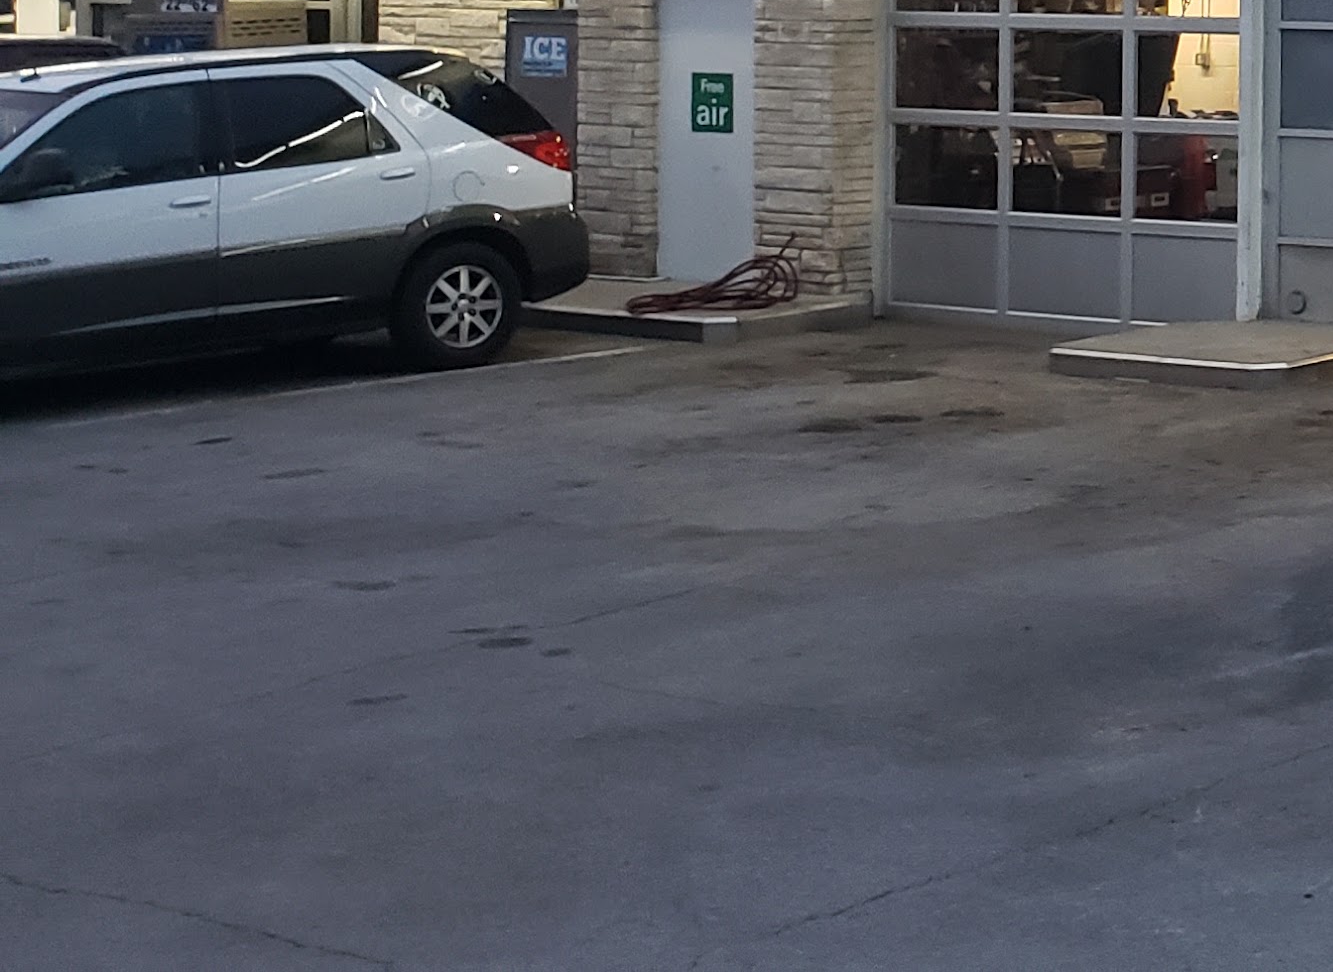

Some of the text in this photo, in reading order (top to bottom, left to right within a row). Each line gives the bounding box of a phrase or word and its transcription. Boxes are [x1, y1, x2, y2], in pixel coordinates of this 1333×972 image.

[524, 36, 567, 59] ICE
[701, 78, 725, 94] Free
[696, 98, 729, 126] air
